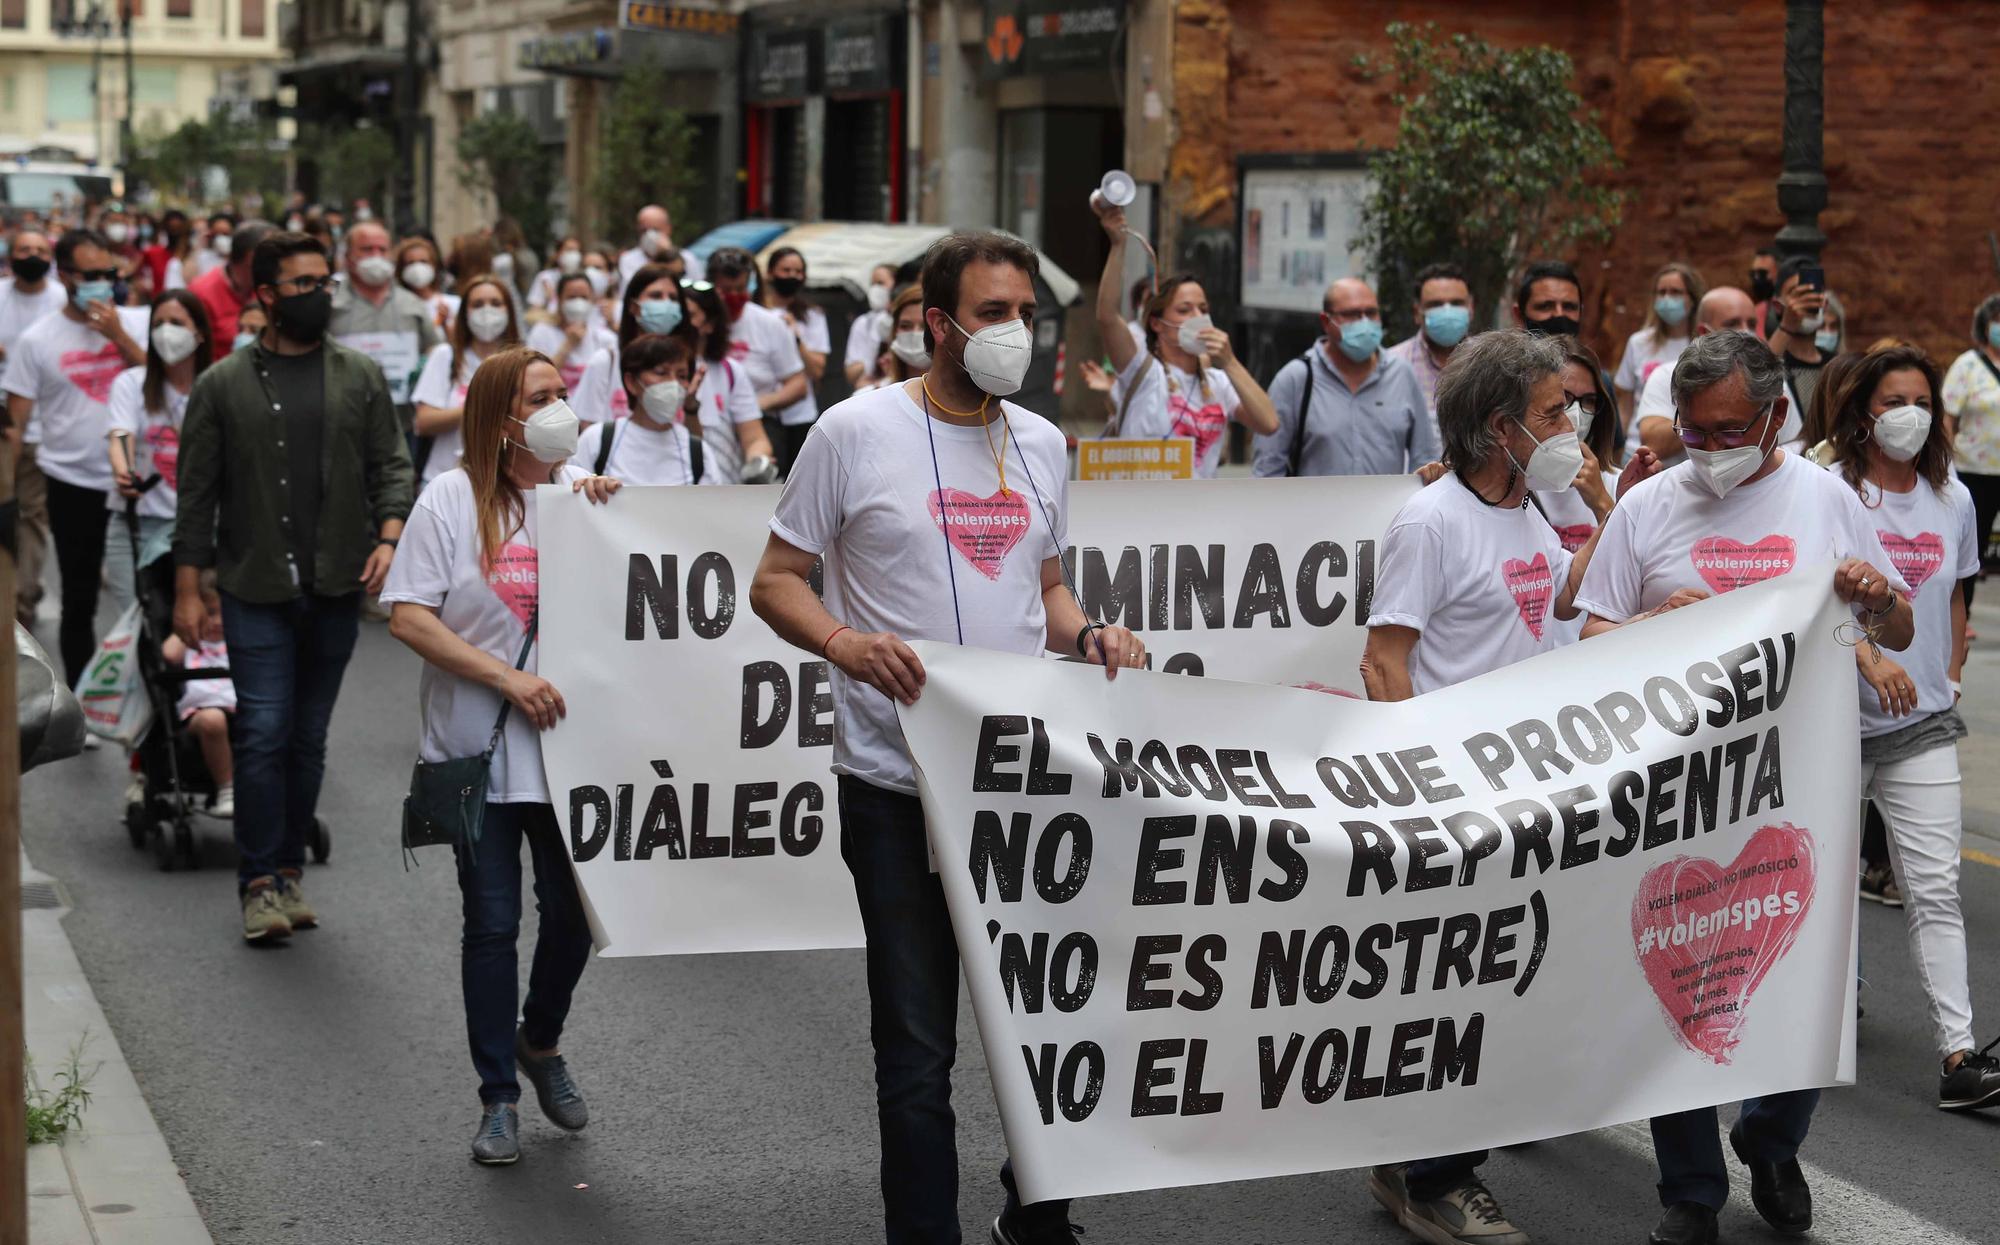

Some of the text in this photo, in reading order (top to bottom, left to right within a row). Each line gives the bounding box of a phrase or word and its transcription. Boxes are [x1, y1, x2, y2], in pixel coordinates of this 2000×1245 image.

[1164, 447, 1181, 464] DE
[935, 512, 1027, 528] #volemspes
[1695, 557, 1790, 571] #volemspes
[625, 551, 736, 641] NO
[973, 631, 1797, 809] EL MODEL QUE PROPOSEU
[569, 759, 824, 863] DIÀLEG
[968, 725, 1785, 906] NO ENS REPRESENTA
[1649, 892, 1684, 911] VOLEM
[1685, 878, 1718, 902] DIÀLEG
[1723, 873, 1739, 887] NO
[1739, 855, 1798, 881] IMPOSICIÓ
[1126, 933, 1228, 1012] ES
[1249, 888, 1550, 1010] NOSTRE)
[1637, 890, 1801, 956] #volemspes
[1671, 946, 1757, 980] Volem millorar-los,
[1677, 965, 1749, 994] no eliminar-los.
[1682, 1000, 1739, 1026] precarietat
[1693, 985, 1728, 1006] No més
[1130, 1037, 1224, 1118] EL
[1257, 1011, 1485, 1110] VOLEM
